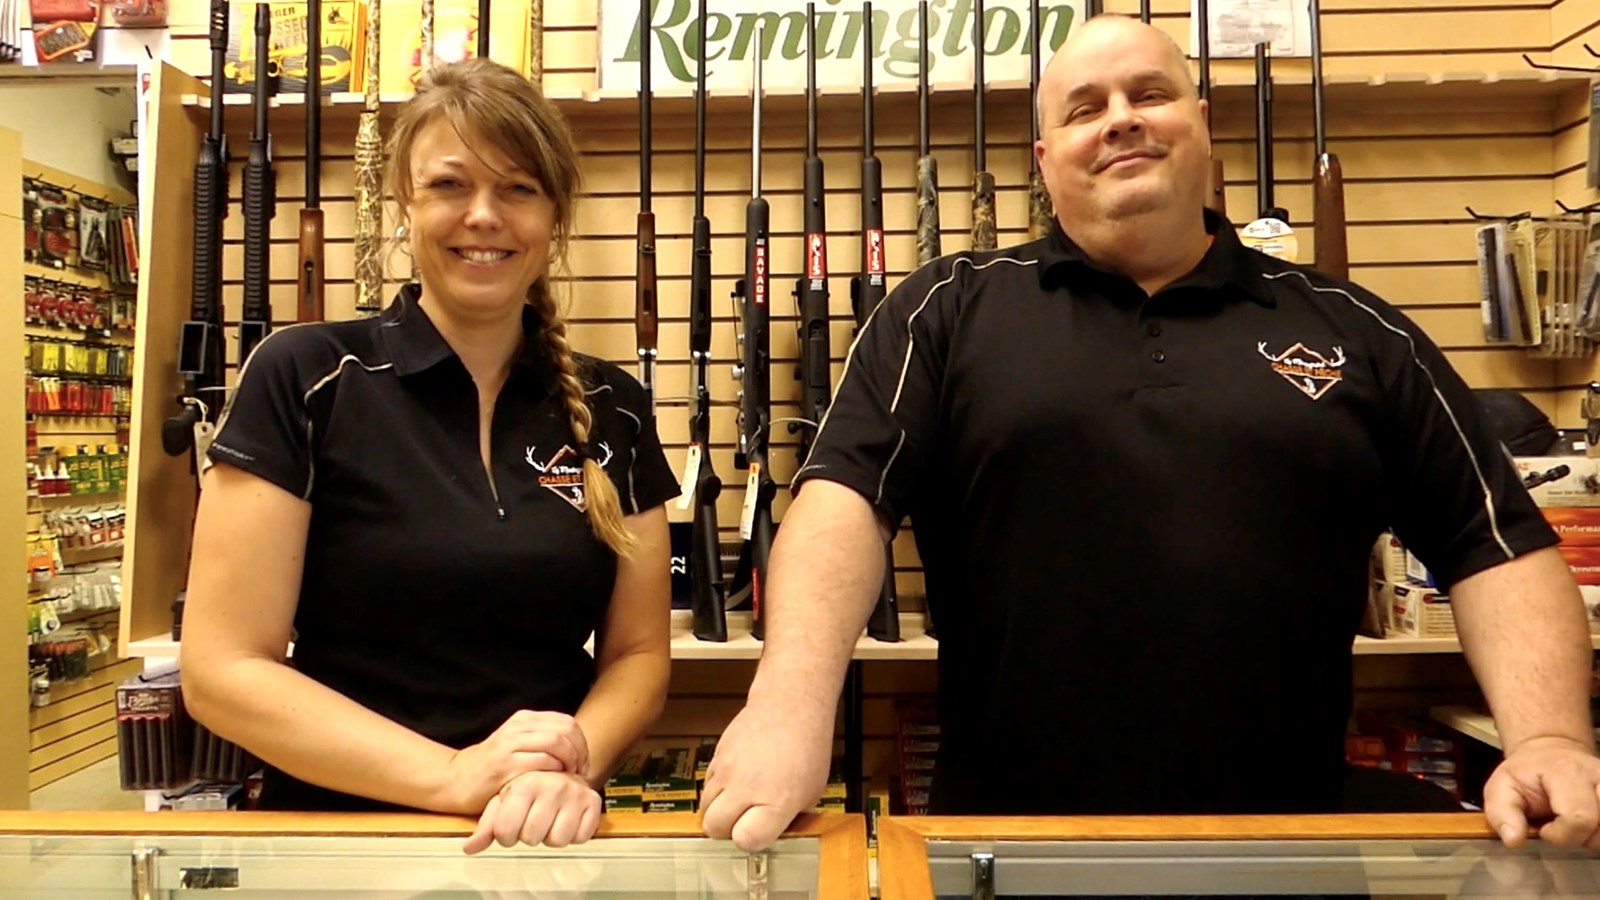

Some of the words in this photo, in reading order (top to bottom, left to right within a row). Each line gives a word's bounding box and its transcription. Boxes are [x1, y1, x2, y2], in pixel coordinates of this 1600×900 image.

[612, 0, 1075, 83] Remington
[755, 247, 765, 304] SAVAGE
[670, 556, 687, 575] 22
